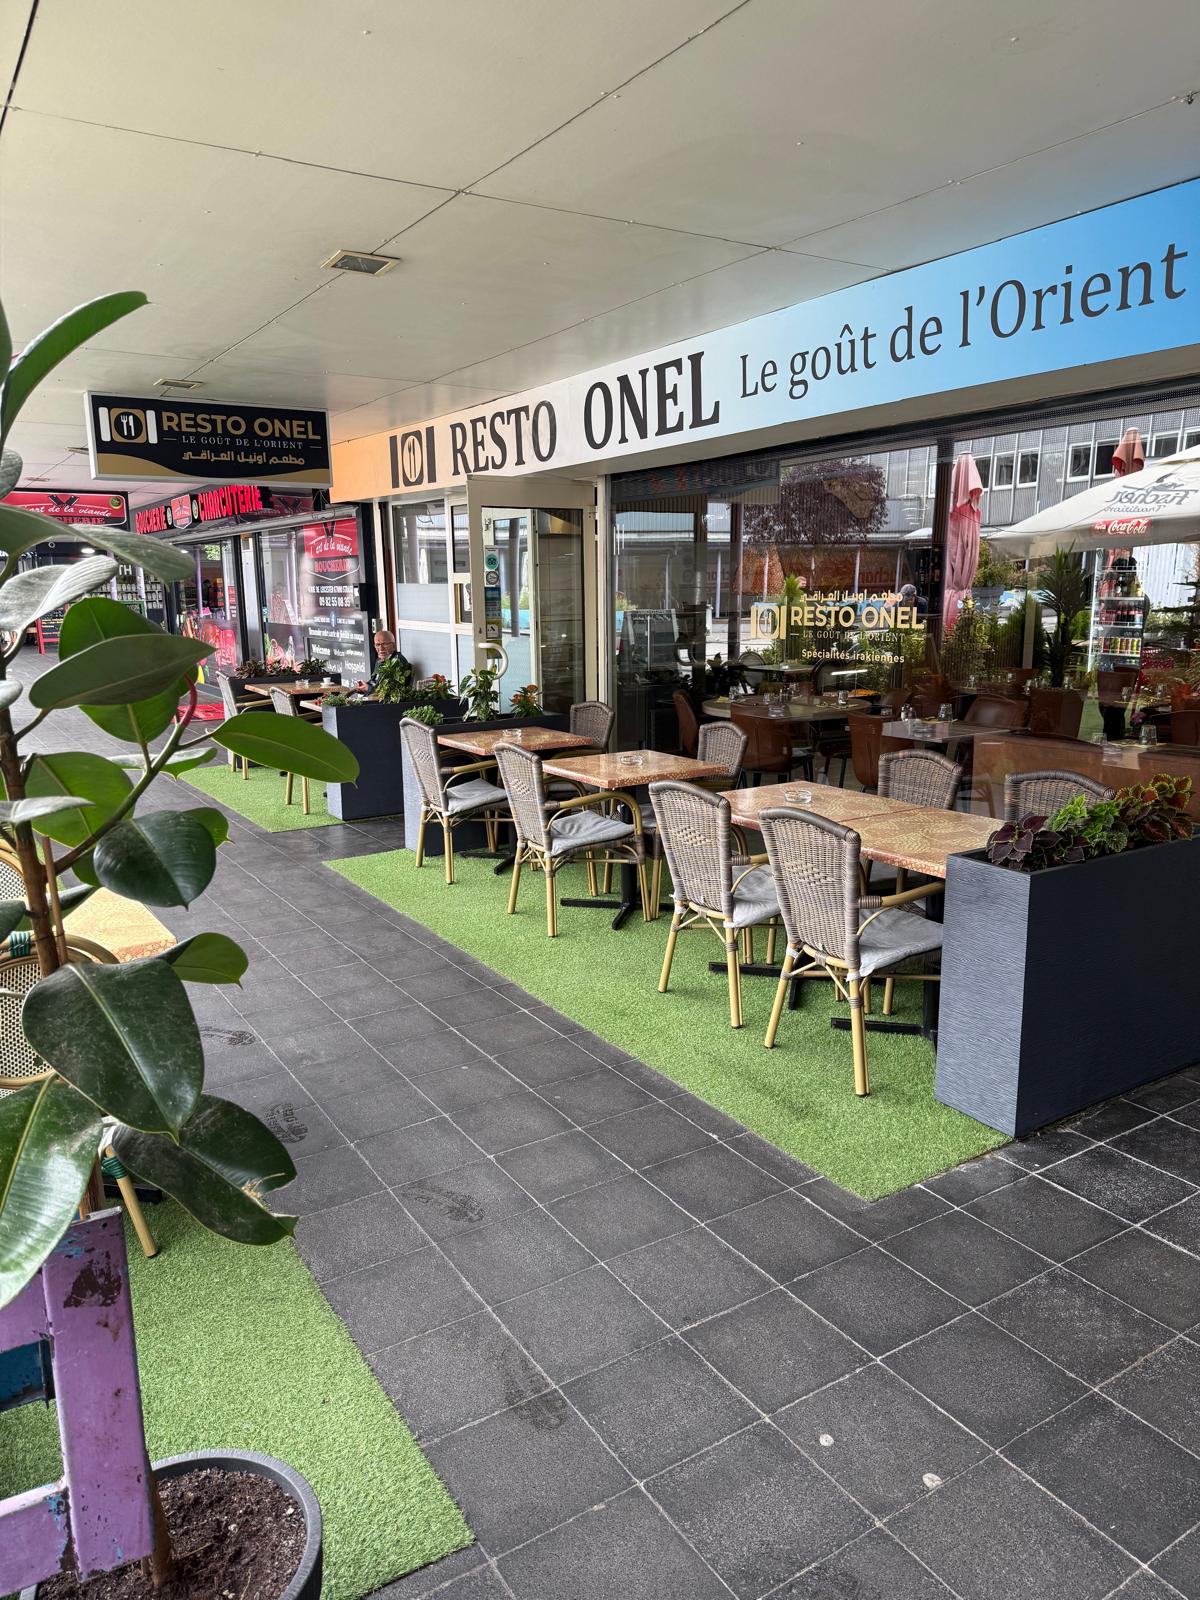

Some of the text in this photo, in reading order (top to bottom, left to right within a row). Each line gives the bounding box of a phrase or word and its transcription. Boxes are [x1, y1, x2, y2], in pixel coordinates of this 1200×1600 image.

[740, 243, 1188, 400] Le goût de l'Orient
[162, 411, 321, 440] RESTO ONEL
[450, 351, 720, 476] RESTO ONEL
[182, 435, 303, 449] LE GOÛT DE L'ORIENT
[48, 505, 61, 513] de
[64, 505, 75, 513] la
[79, 508, 112, 517] viande
[198, 485, 263, 522] CHARCUTERIE
[136, 506, 167, 535] BOUCHERIE
[790, 606, 925, 629] RESTO ONEL
[802, 649, 905, 664] Spécialités irakiennes
